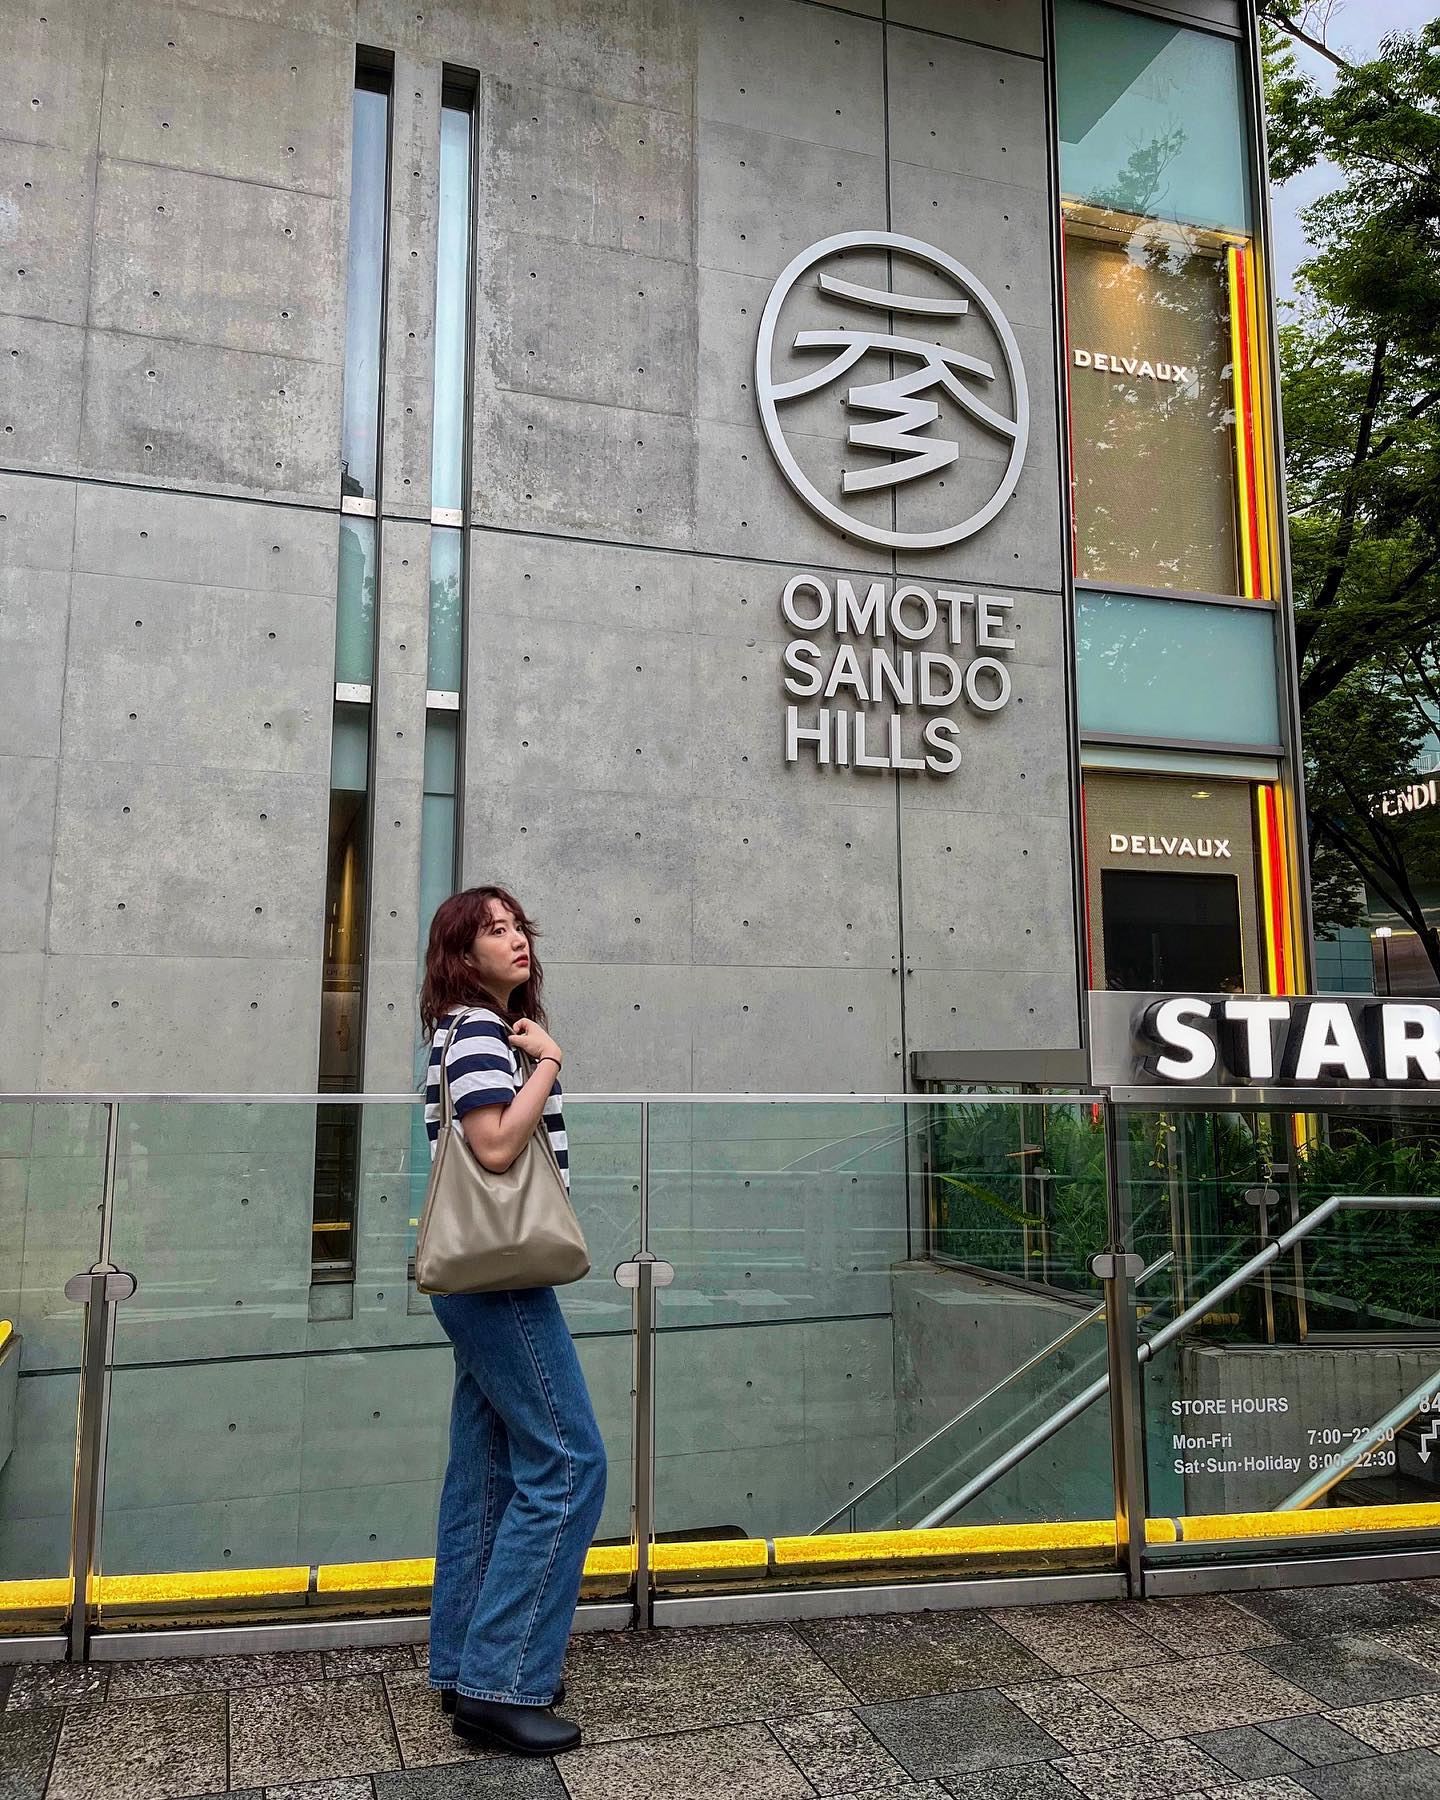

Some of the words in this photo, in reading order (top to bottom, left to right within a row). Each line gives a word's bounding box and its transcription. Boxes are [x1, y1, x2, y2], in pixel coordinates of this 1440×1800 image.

[1073, 349, 1189, 383] DELVAUX
[781, 574, 1016, 650] OMOTE
[783, 639, 1012, 711] SANDO
[785, 705, 962, 773] HILLS
[1109, 834, 1232, 858] DELVAUX
[1155, 998, 1440, 1081] STAR
[1171, 1399, 1227, 1416] STORE
[1231, 1397, 1289, 1413] HOURS
[1172, 1433, 1232, 1449] Mon-Fri
